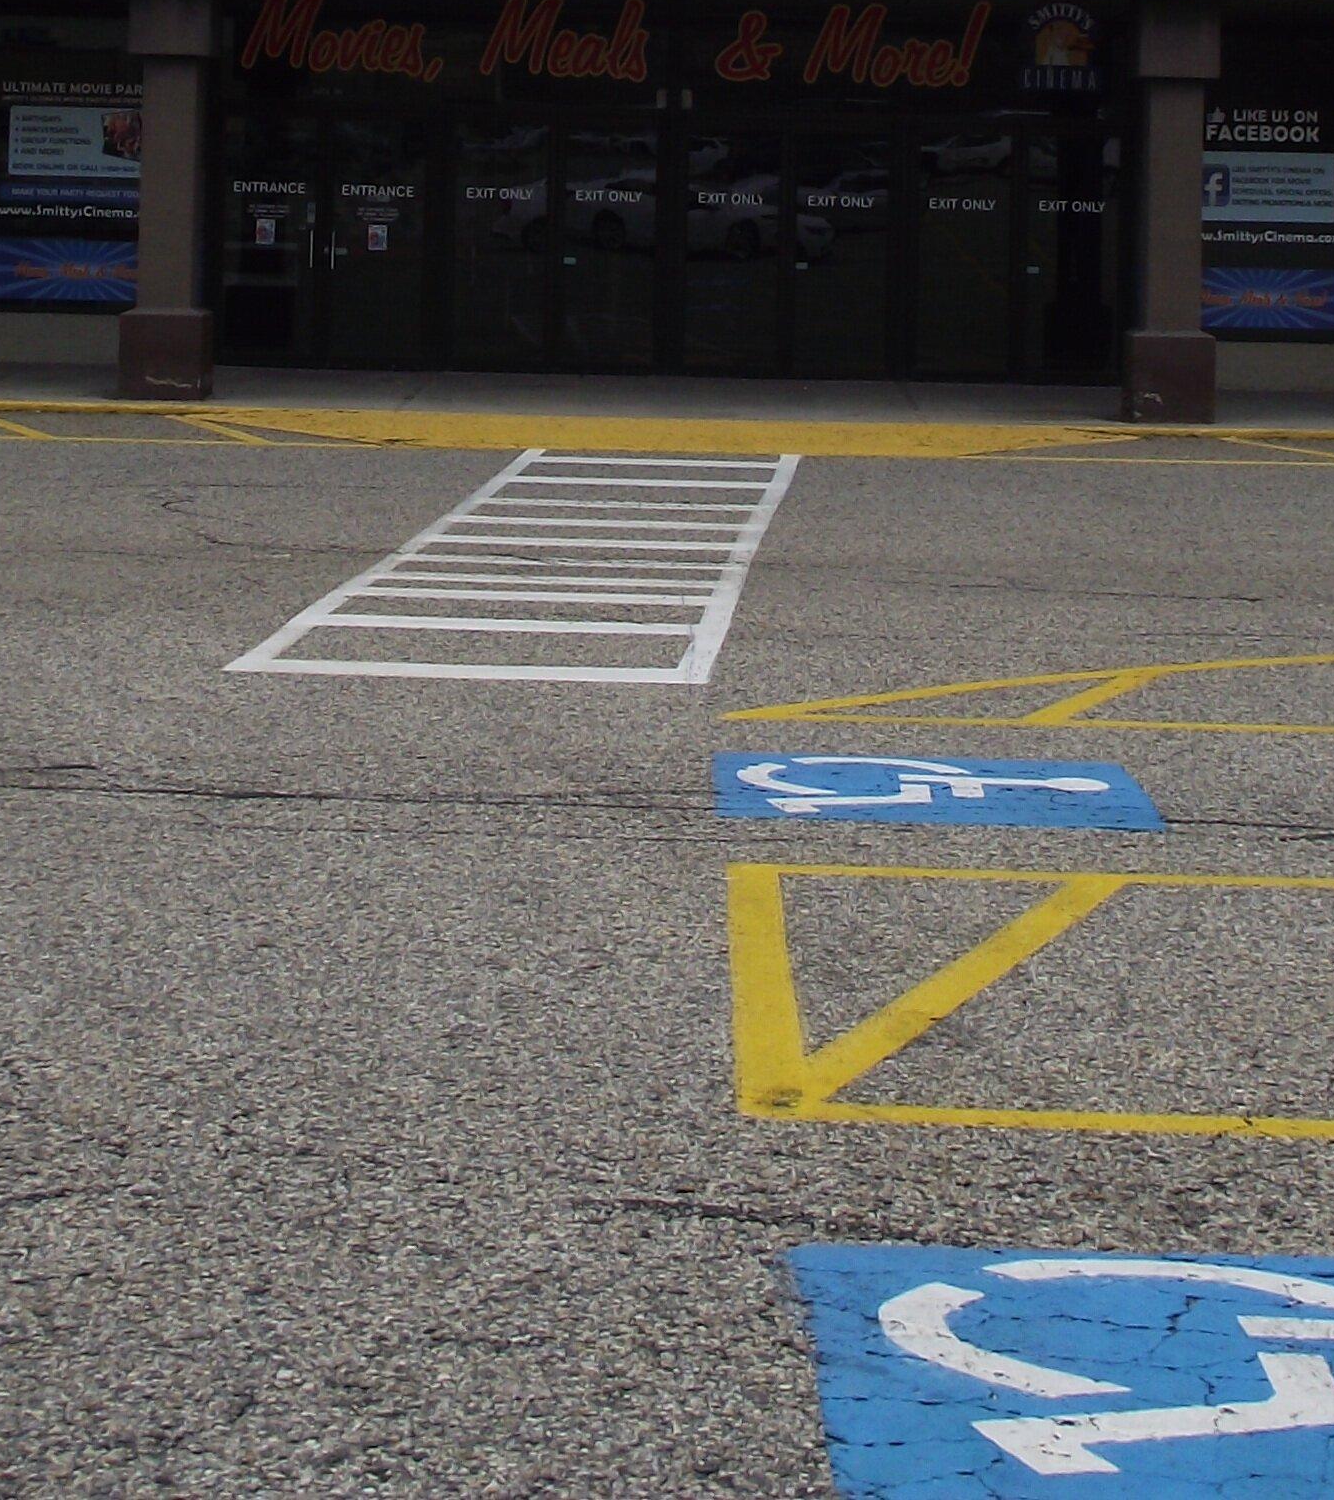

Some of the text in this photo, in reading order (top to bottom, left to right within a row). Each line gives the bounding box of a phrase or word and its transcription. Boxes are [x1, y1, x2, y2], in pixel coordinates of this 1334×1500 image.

[715, 9, 783, 83] &
[802, 0, 991, 88] More!
[1021, 67, 1098, 92] CINEMA
[2, 81, 142, 96] ULTIMATE MOVIE PAR
[1233, 108, 1318, 123] LIKE US ON
[1205, 124, 1320, 143] FACEBOOK
[232, 178, 307, 196] ENTRANCE
[340, 183, 415, 199] ENTRANCE
[465, 187, 534, 202] EXIT ONLY
[574, 189, 644, 204] EXIT ONLY
[696, 192, 765, 207] EXIT ONLY
[807, 194, 875, 209] EXIT ONLY
[928, 197, 997, 212] EXIT ONLY
[1038, 199, 1107, 214] EXIT ONLY
